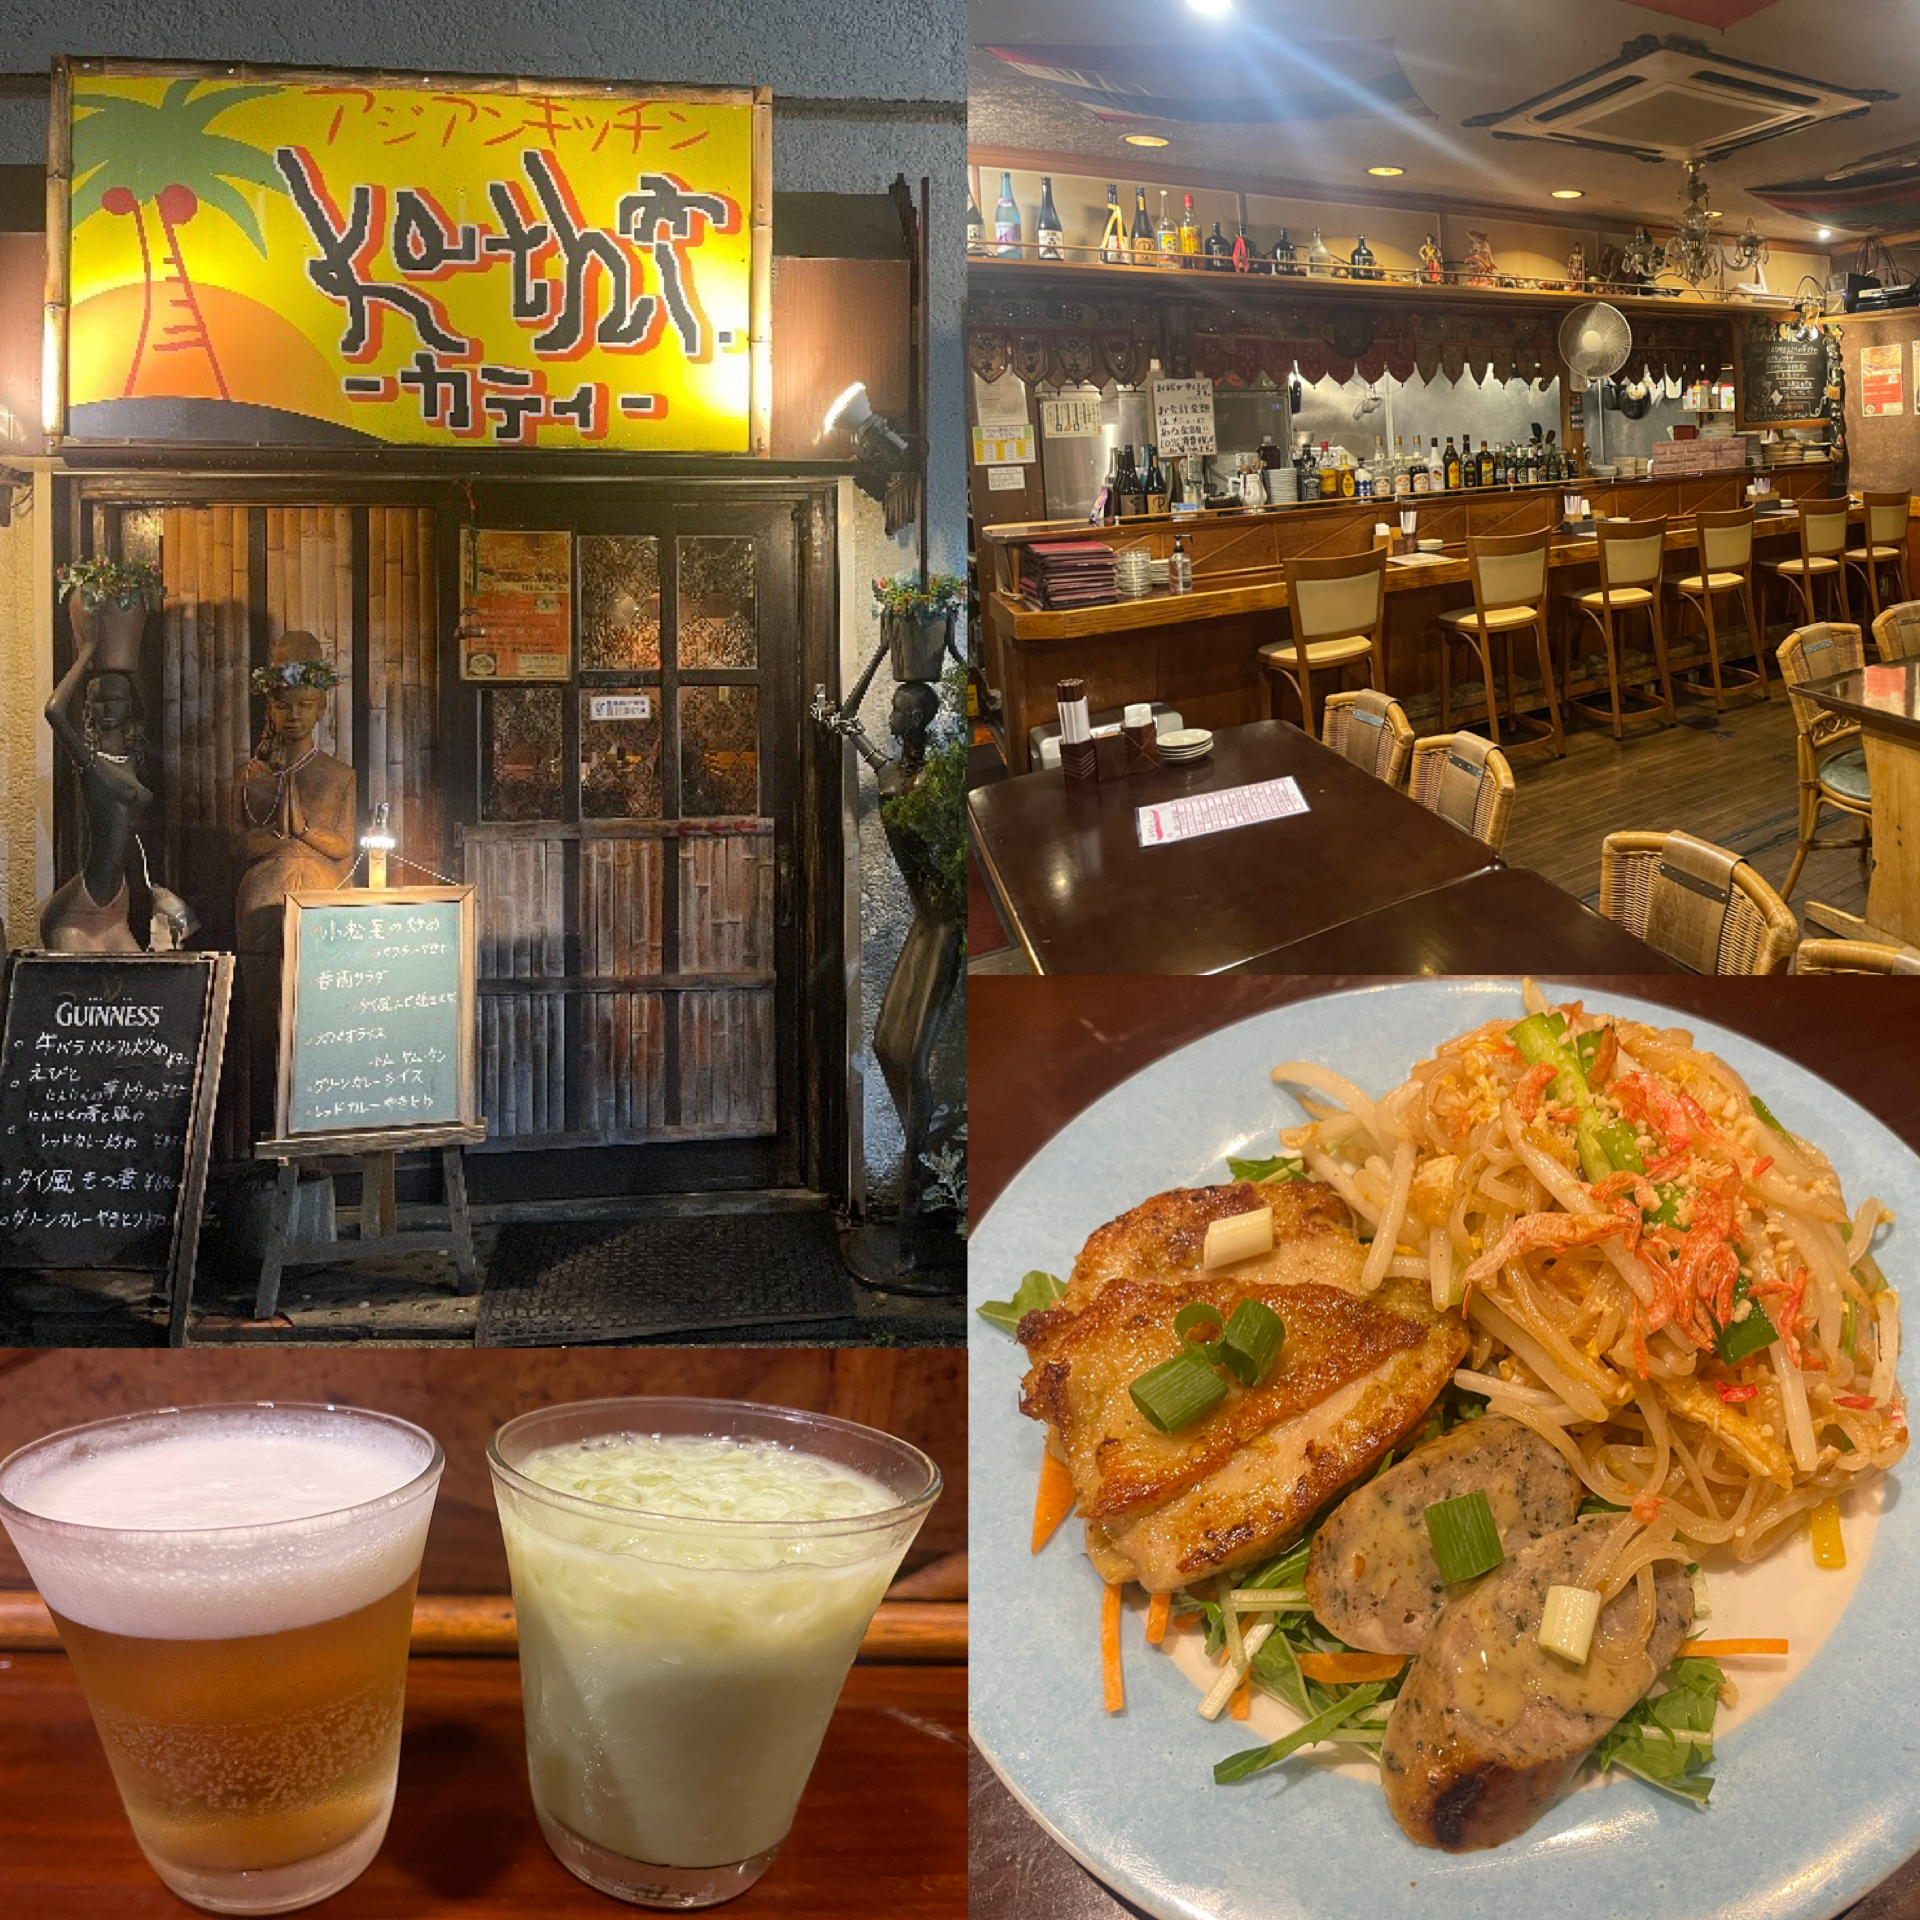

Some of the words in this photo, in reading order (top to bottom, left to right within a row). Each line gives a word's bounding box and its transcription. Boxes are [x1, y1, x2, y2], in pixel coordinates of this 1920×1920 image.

[303, 88, 709, 153] アジアンキッチン
[55, 1001, 162, 1027] GUINNESS
